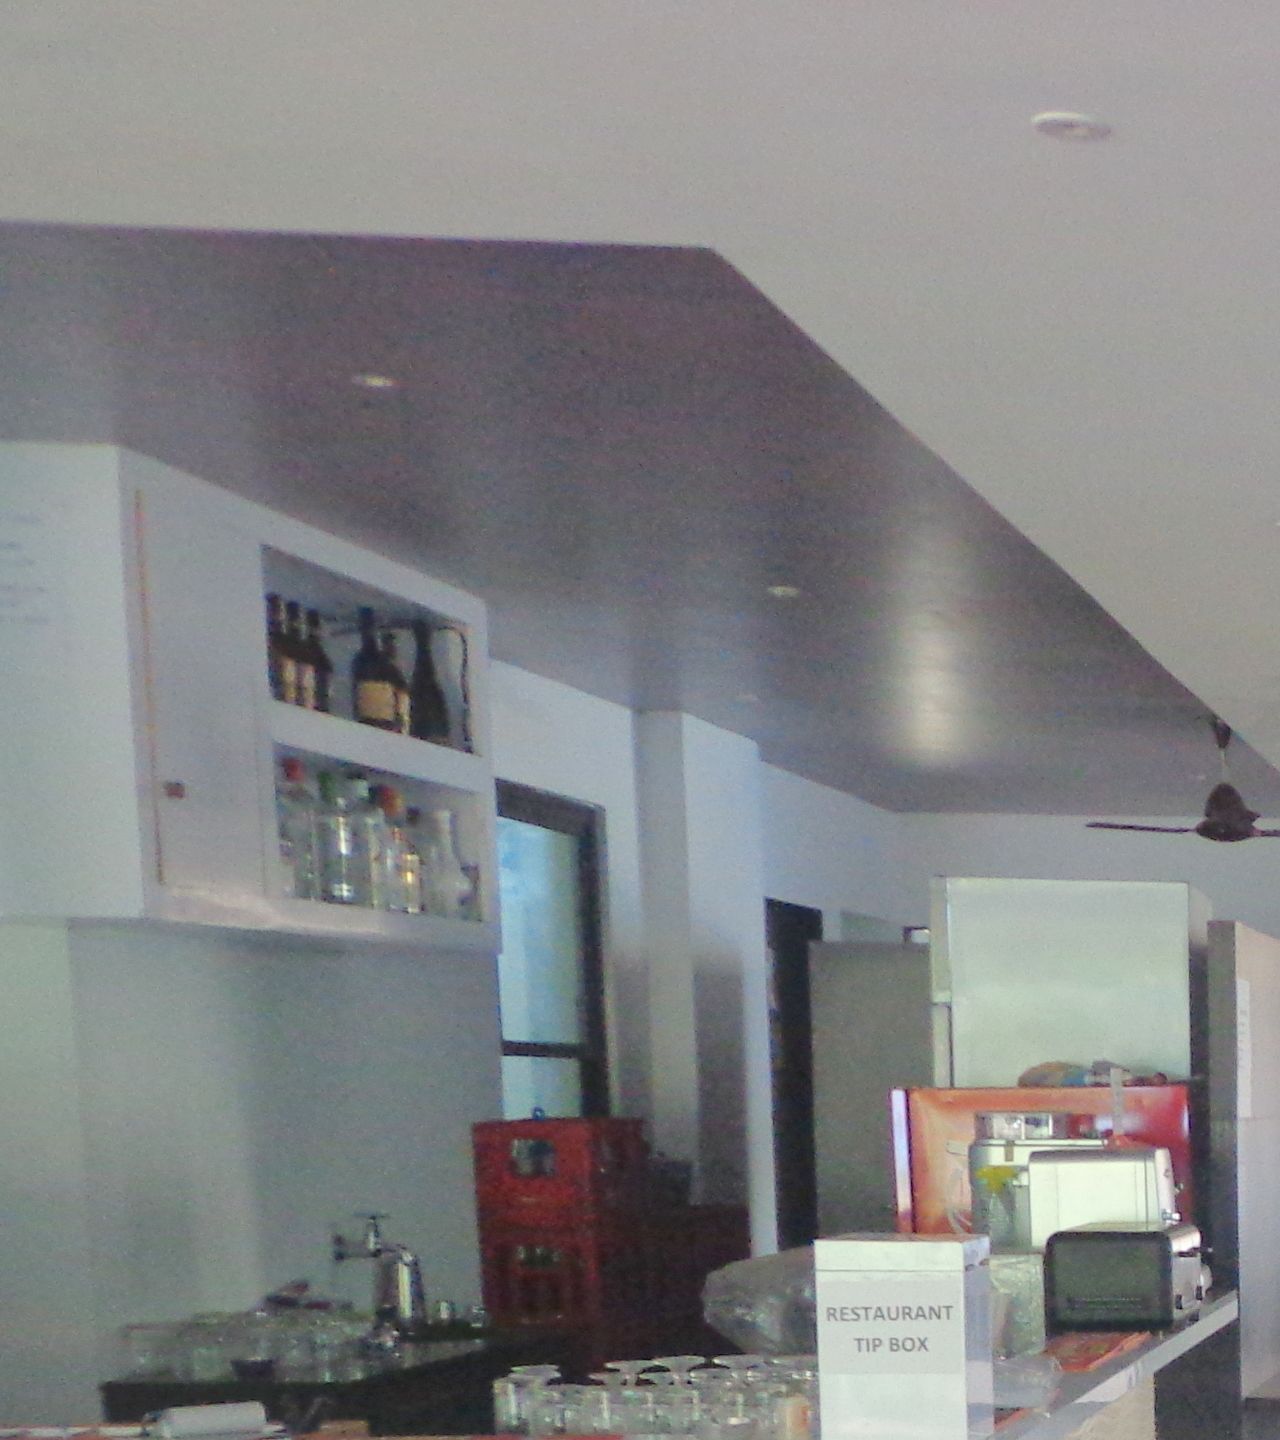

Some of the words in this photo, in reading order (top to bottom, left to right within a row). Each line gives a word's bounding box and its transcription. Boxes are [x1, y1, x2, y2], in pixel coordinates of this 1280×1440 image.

[826, 1305, 954, 1322] RESTAURANT
[854, 1337, 883, 1353] TIP
[889, 1337, 929, 1353] BOX
